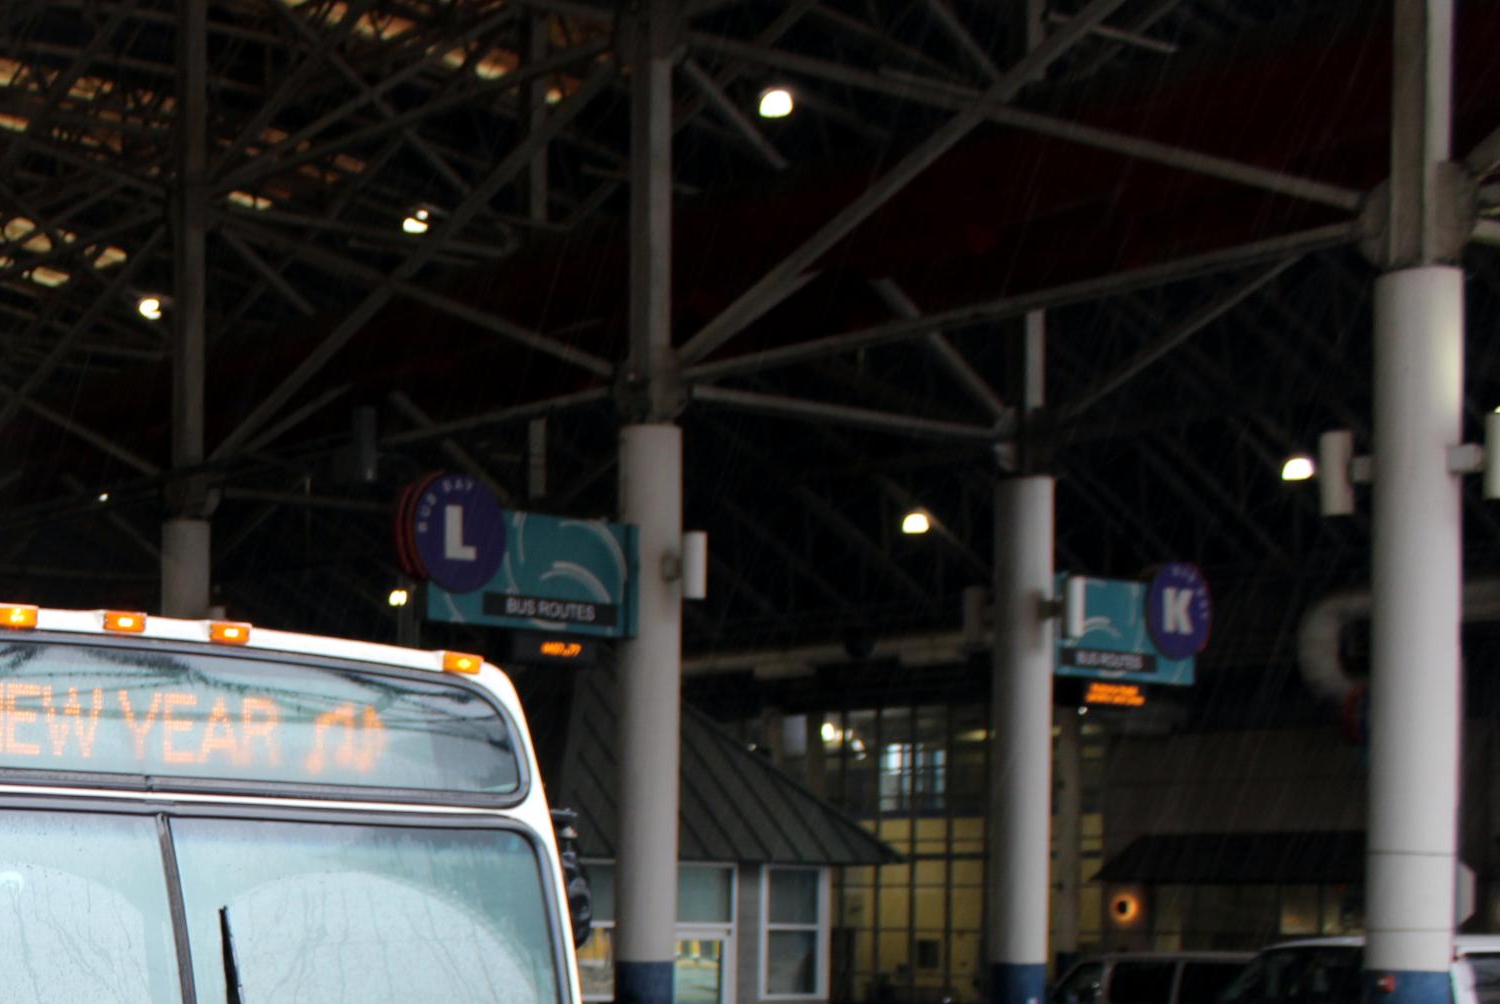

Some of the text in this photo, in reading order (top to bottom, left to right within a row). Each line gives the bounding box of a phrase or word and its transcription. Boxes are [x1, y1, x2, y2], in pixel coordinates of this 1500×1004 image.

[445, 505, 476, 561] L
[505, 597, 596, 622] BUS ROUTES
[1161, 586, 1194, 636] K
[117, 687, 282, 766] YEAR
